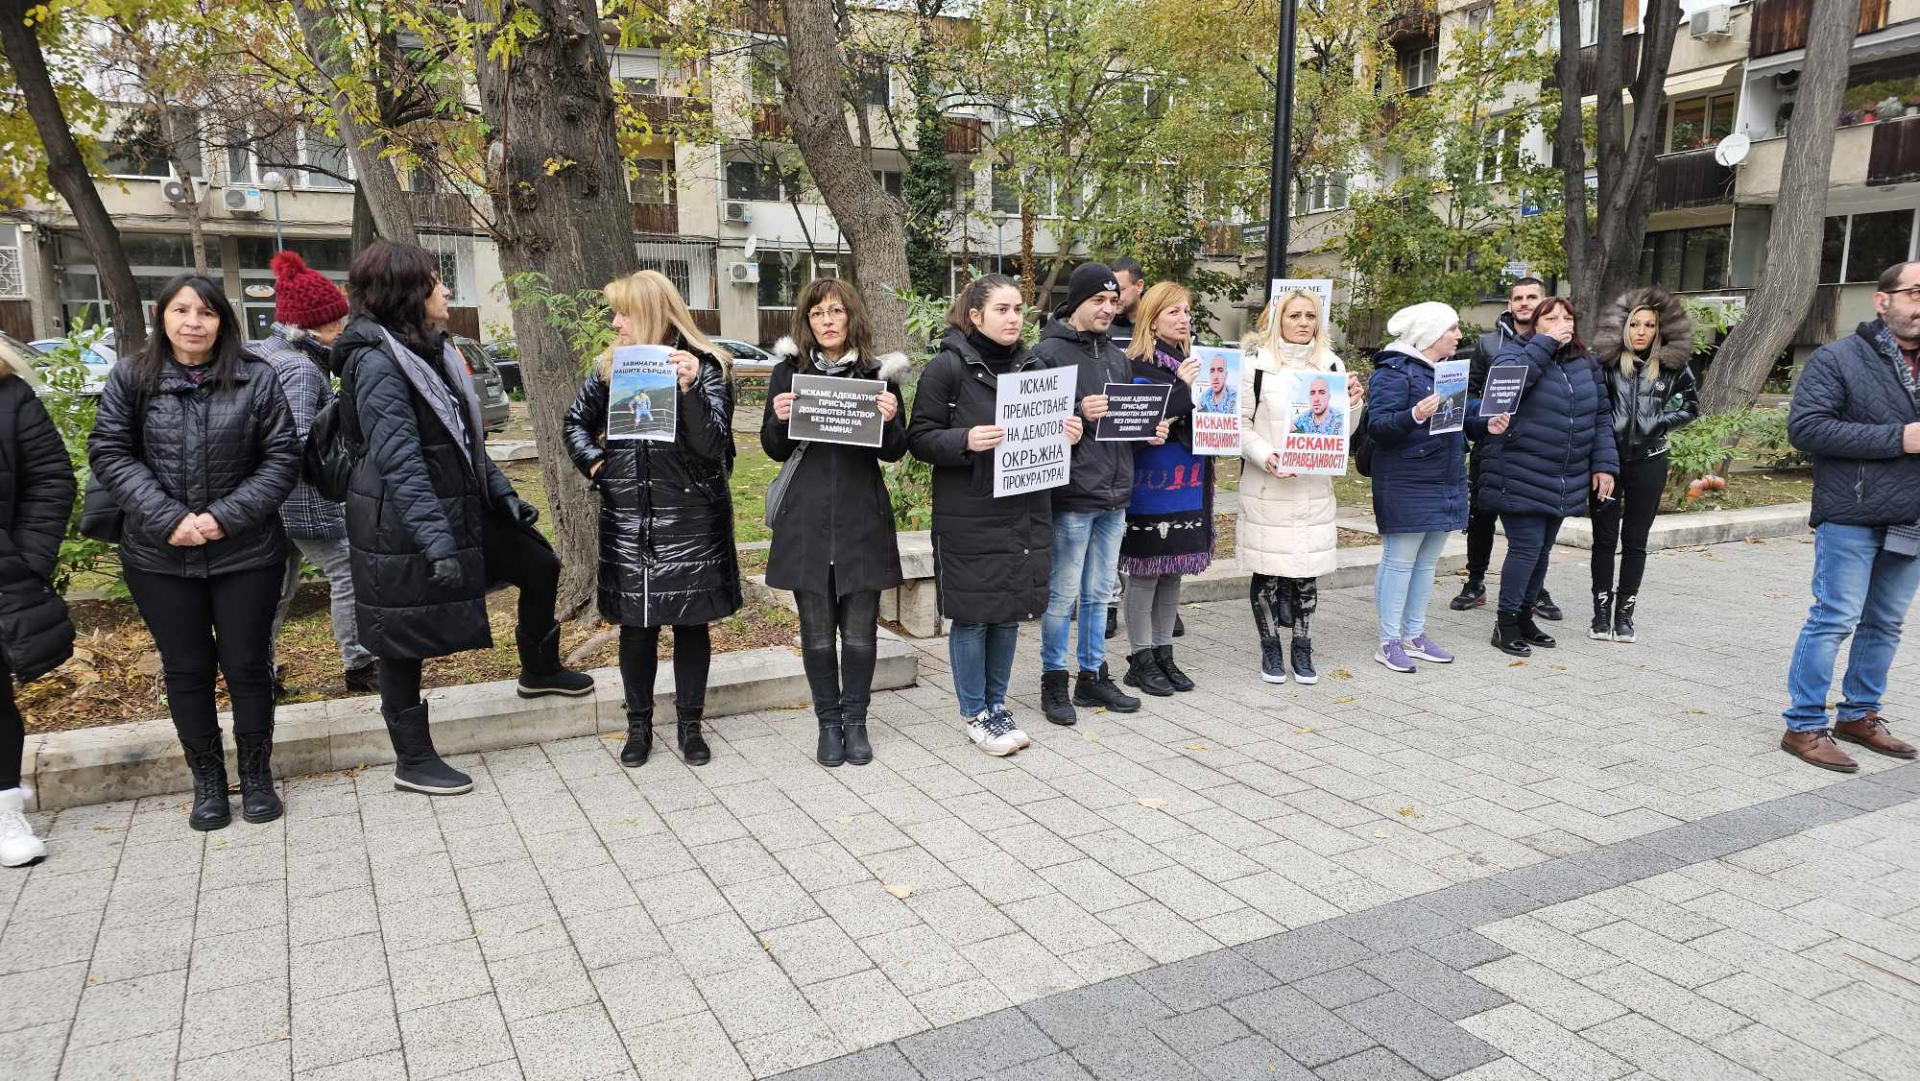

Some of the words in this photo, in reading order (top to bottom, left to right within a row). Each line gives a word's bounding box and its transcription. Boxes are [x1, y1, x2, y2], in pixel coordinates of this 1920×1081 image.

[1020, 375, 1058, 395] ИСКАМЕ
[800, 388, 832, 398] ИСКАМЕ
[832, 391, 876, 402] АДЕКВАТНИ
[798, 405, 846, 416] ДОЖИВОТЕН
[846, 410, 876, 419] ЗАТВОР
[818, 399, 857, 410] ПРИСЪДИ!
[1003, 396, 1069, 420] ПРЕМЕСТВАНЕ
[810, 415, 824, 423] БЕЗ
[825, 416, 850, 425] ПРАВО
[851, 418, 862, 427] НА
[819, 424, 853, 434] ЗАМЯНА!
[1195, 414, 1239, 430] ИСКАМЕ
[1007, 426, 1020, 443] НА
[1021, 420, 1057, 443] ДЕЛОТО
[1058, 419, 1064, 435] В
[1286, 436, 1345, 452] ИСКАМЕ
[1002, 444, 1064, 468] ОКРЪЖНА
[1282, 451, 1345, 470] СПРАВЕДЛИВОСТ!
[1003, 466, 1064, 490] ПРОКУРАТУРА!
